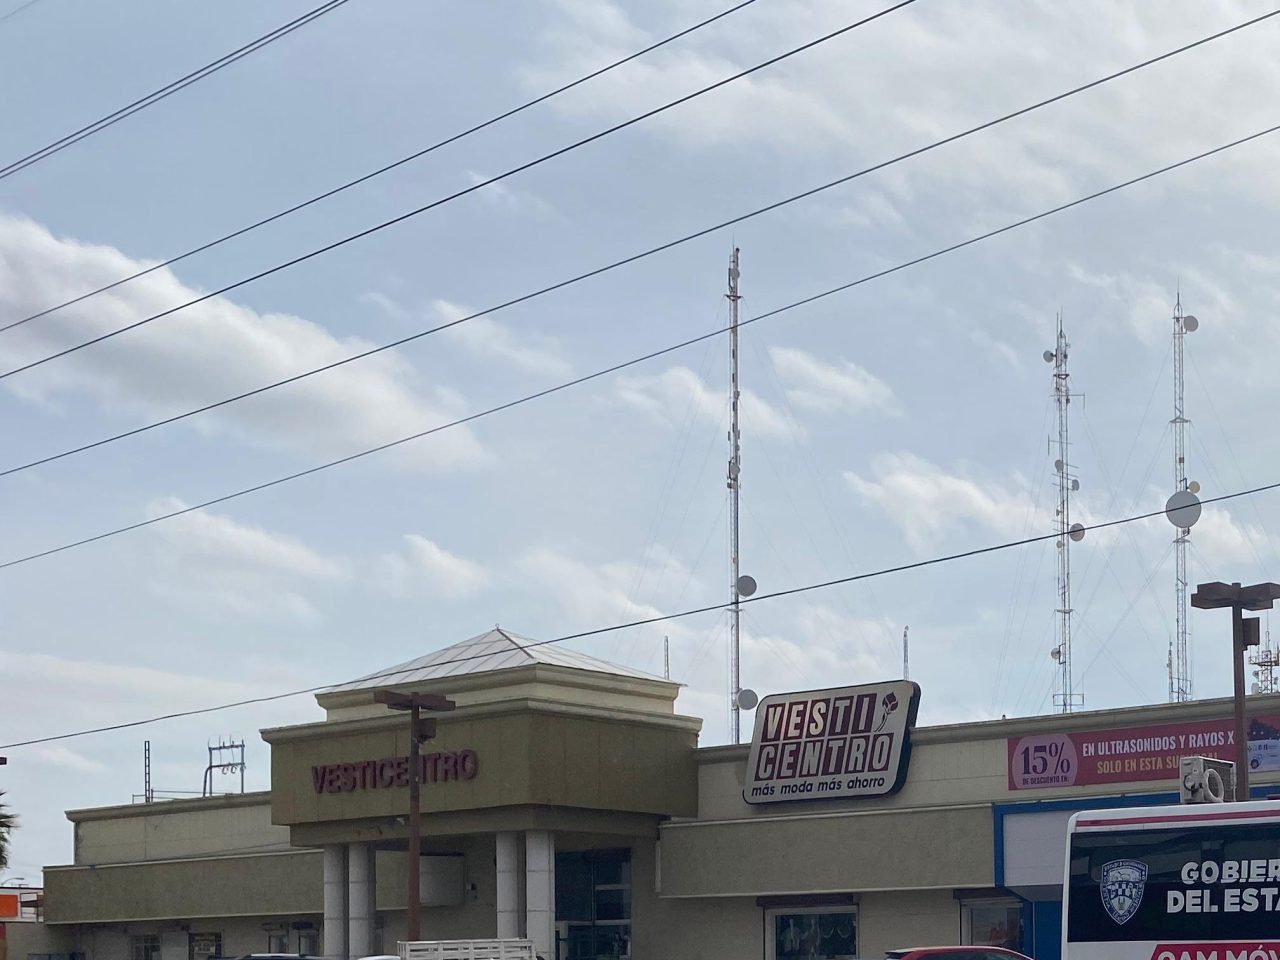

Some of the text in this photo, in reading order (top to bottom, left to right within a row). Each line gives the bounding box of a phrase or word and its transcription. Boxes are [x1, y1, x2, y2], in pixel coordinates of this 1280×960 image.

[766, 696, 869, 740] VESTI
[1083, 731, 1235, 757] EN ULTRASONIDOS Y RAYOS X
[758, 735, 891, 780] CENTRO
[1021, 742, 1070, 775] 15%
[1097, 759, 1122, 774] SOLO
[1125, 759, 1137, 772] EN
[1140, 757, 1162, 771] ESTA
[751, 776, 885, 797] más moda más ahorro
[1166, 889, 1219, 913] DEL
